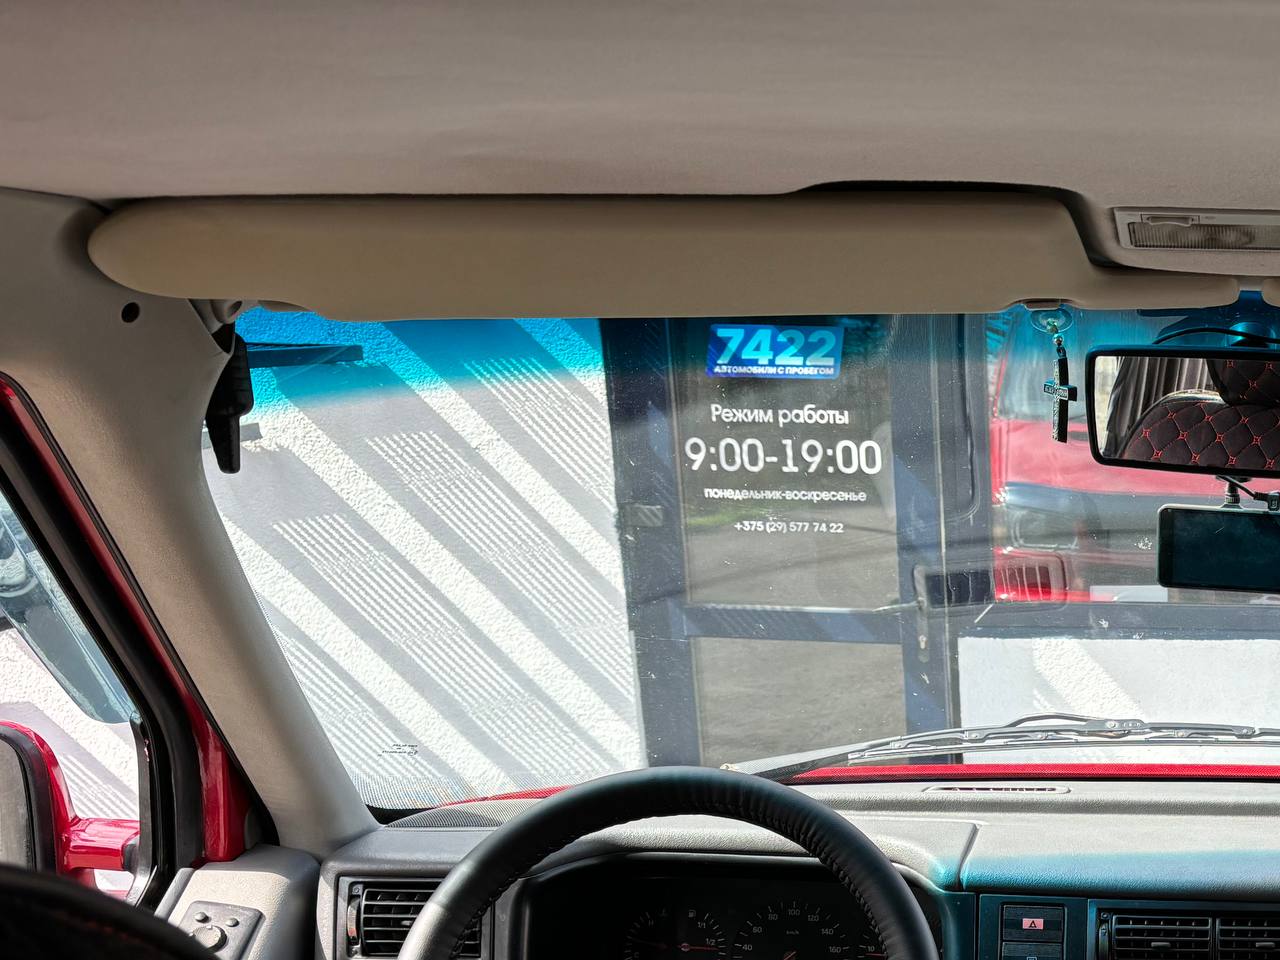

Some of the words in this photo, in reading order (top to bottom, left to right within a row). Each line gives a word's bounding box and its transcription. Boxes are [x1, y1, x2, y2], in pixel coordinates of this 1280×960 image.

[716, 328, 836, 366] 7422
[714, 366, 777, 375] АВТОМОБИЛИ
[777, 366, 784, 374] С
[785, 366, 834, 375] ПРОБЕГОМ
[710, 404, 773, 422] Режим
[778, 404, 849, 427] работы
[684, 437, 882, 474] 9:00-19:00
[704, 488, 867, 503] понедельник-воскресенье
[734, 521, 764, 532] +375
[766, 521, 787, 534] (29)
[789, 522, 809, 532] 577
[813, 522, 826, 532] 74
[829, 523, 844, 533] 22
